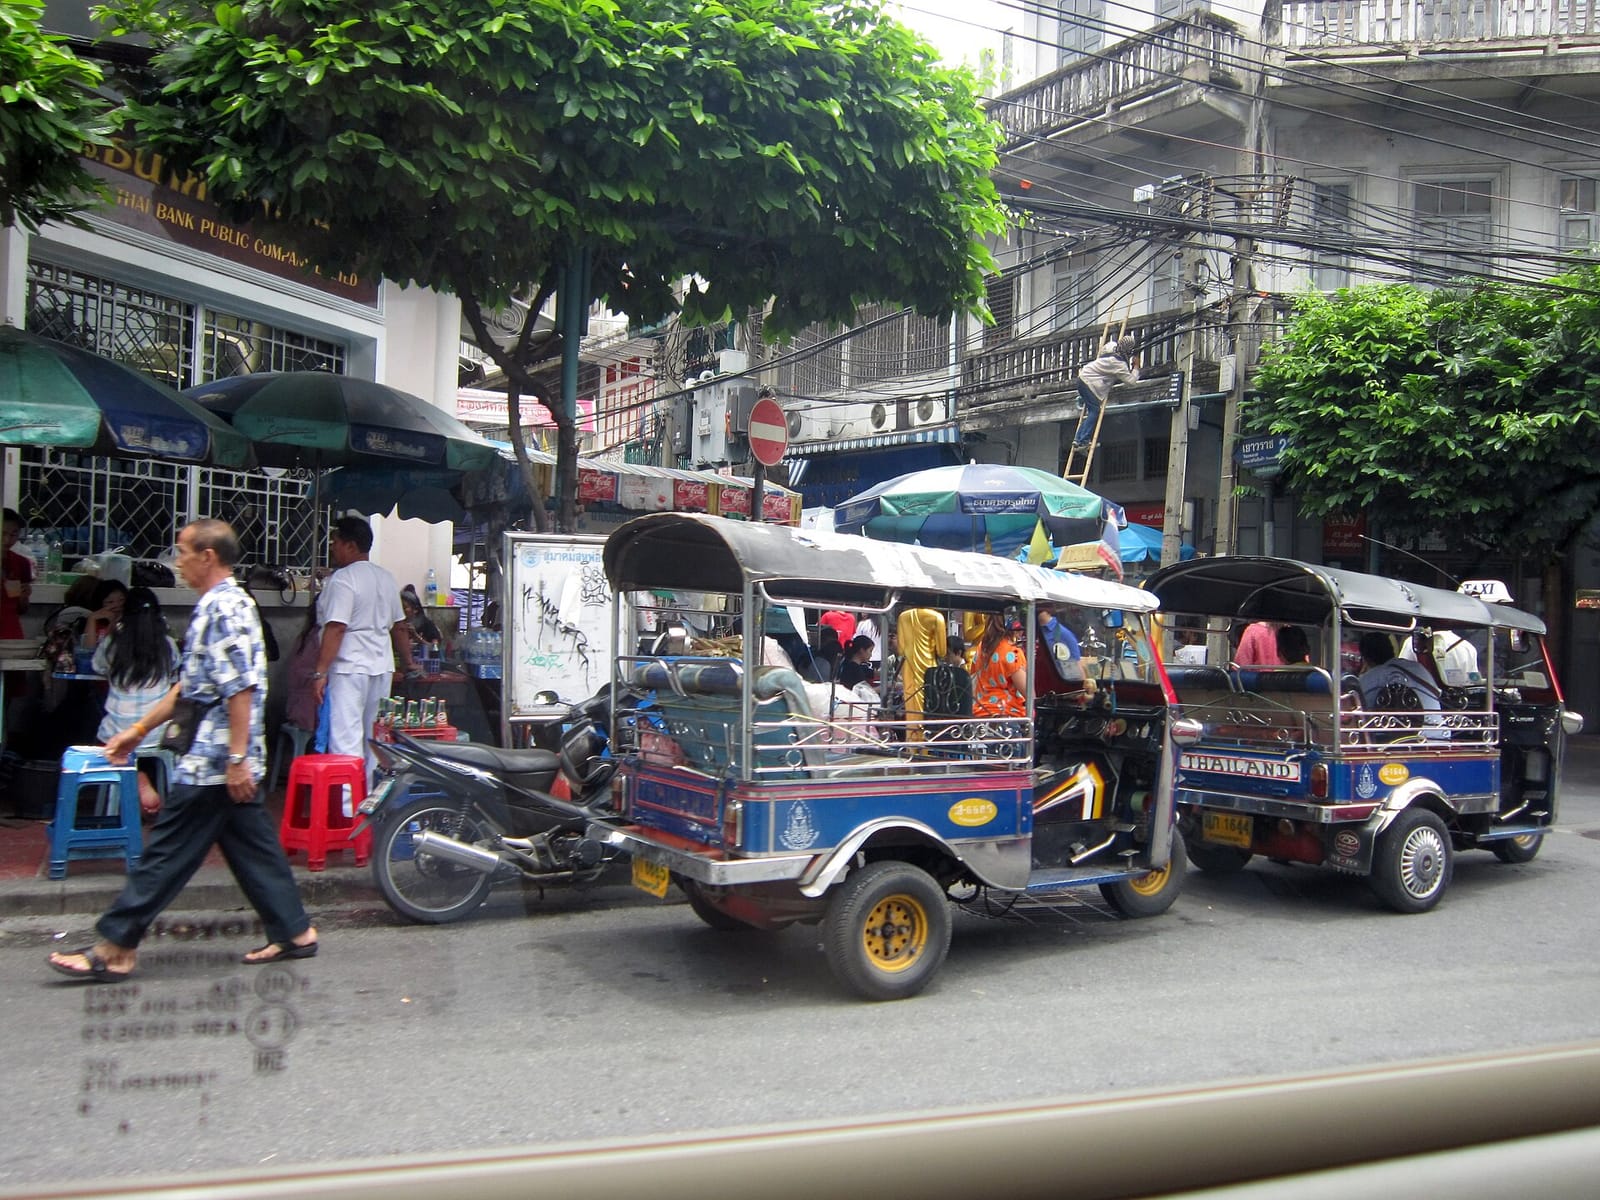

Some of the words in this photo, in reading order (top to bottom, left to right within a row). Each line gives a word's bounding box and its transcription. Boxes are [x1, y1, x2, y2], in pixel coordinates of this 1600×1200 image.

[116, 188, 150, 215] THAI
[156, 202, 195, 231] BANK
[200, 217, 249, 250] PUBLIC
[1242, 439, 1274, 454] เยาวราช
[973, 496, 1036, 509] ธนาคารกรุงไทย
[1464, 583, 1495, 595] TAXI
[1185, 754, 1291, 778] THAILAND
